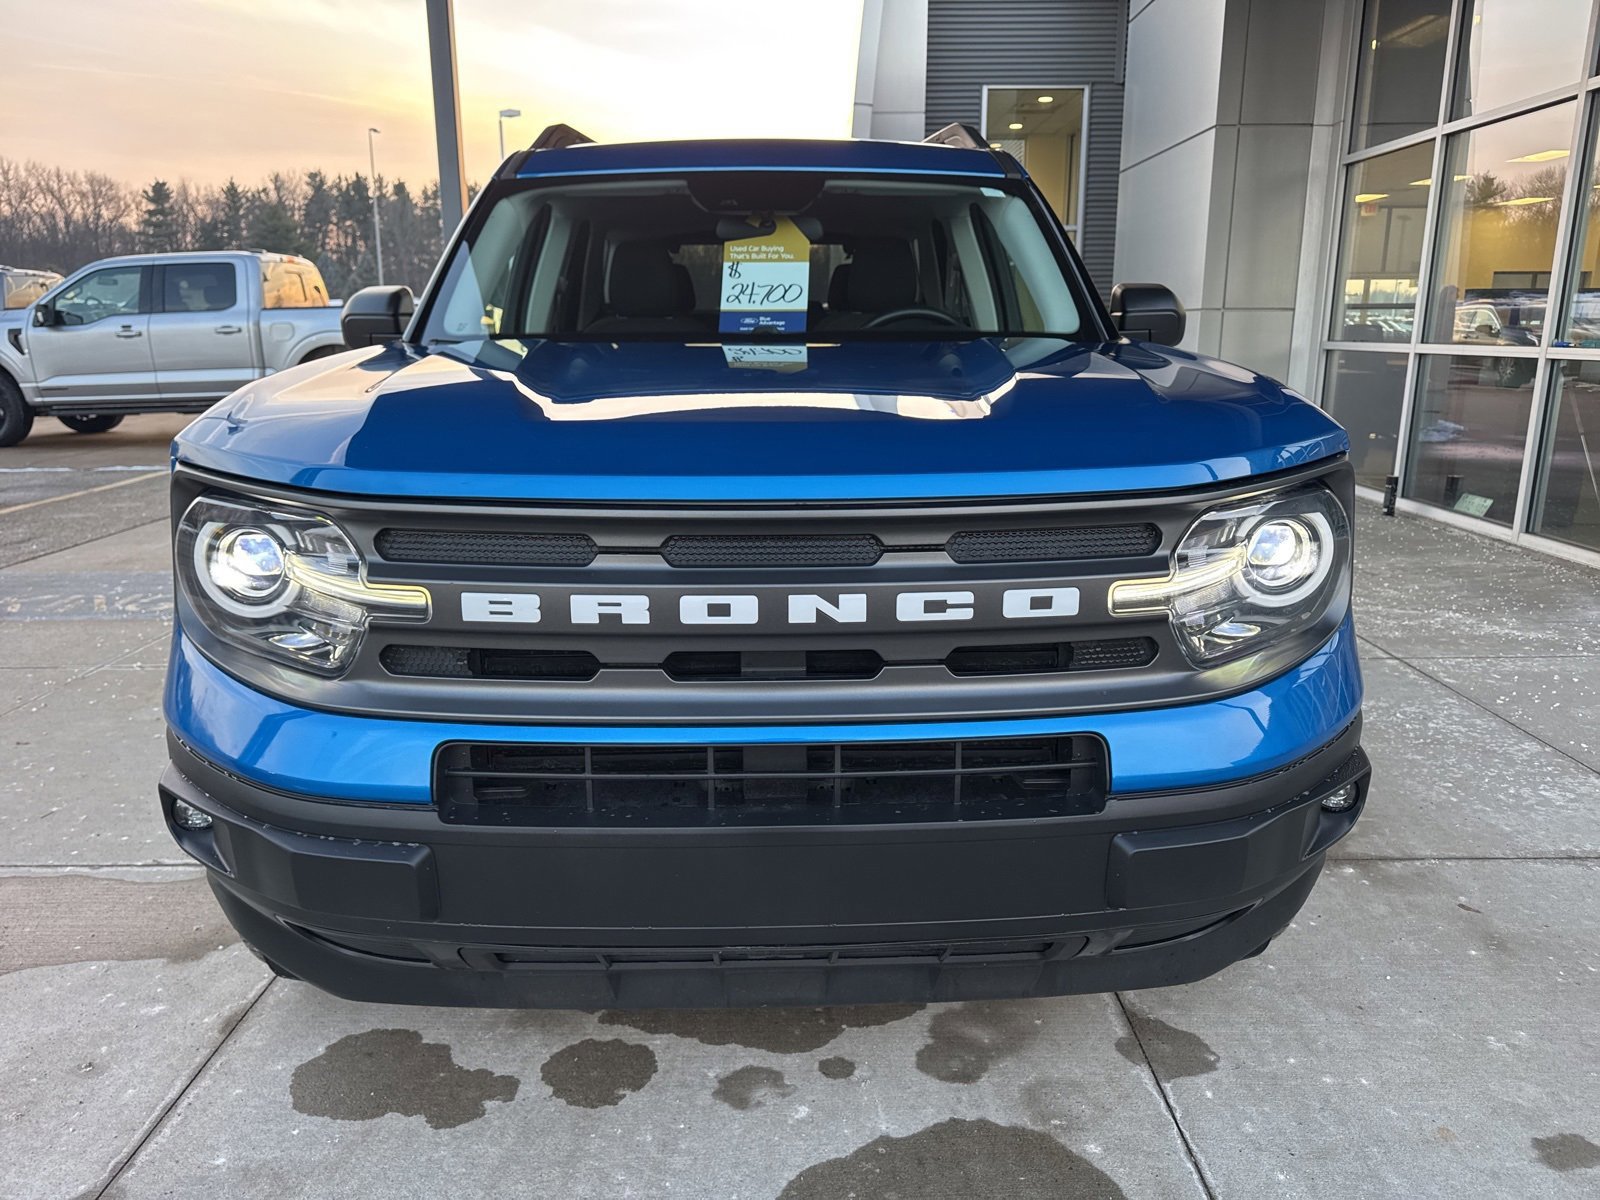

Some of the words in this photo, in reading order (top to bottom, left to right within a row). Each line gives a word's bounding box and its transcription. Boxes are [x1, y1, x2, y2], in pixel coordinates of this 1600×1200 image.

[761, 245, 785, 253] Buying
[728, 261, 741, 279] $
[460, 587, 1080, 625] BRONCO
